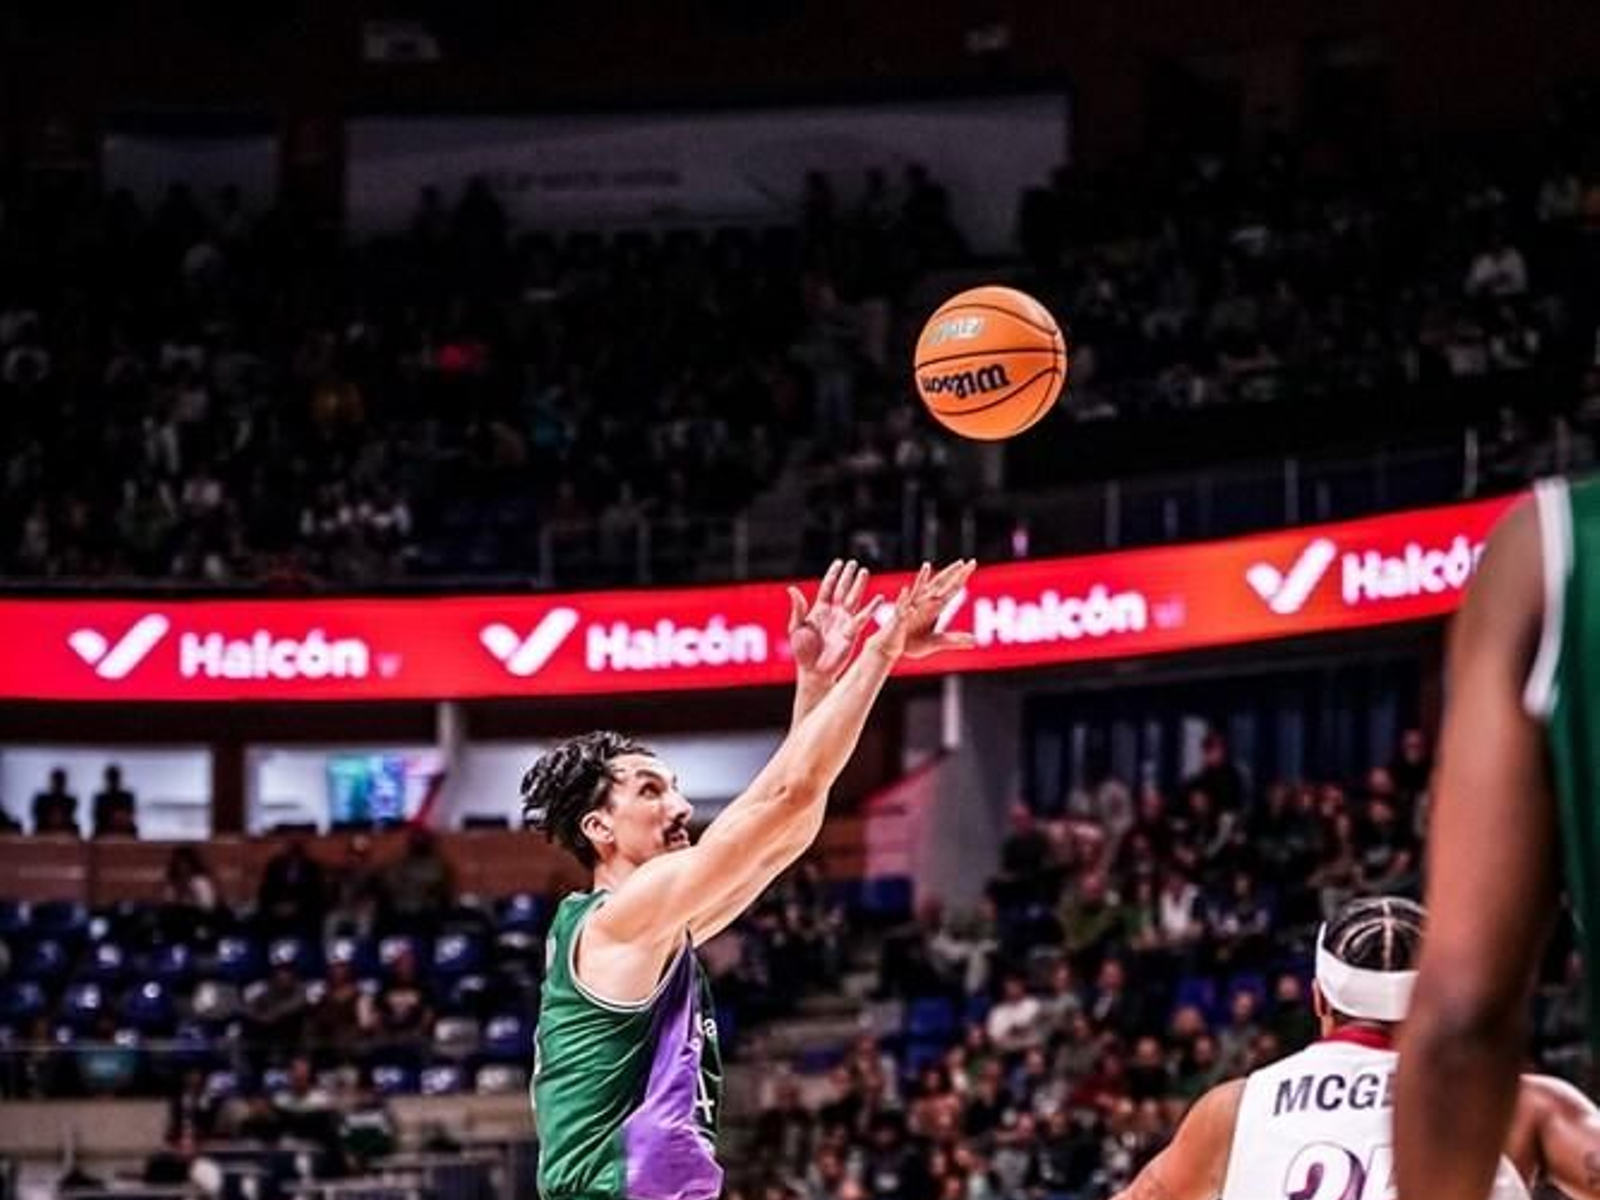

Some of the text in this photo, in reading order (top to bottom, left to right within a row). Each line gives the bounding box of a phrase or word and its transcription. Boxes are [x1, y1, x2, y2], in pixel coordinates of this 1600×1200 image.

[586, 615, 767, 671] Halcón
[973, 585, 1147, 646] Halcón
[180, 628, 370, 679] Halcón
